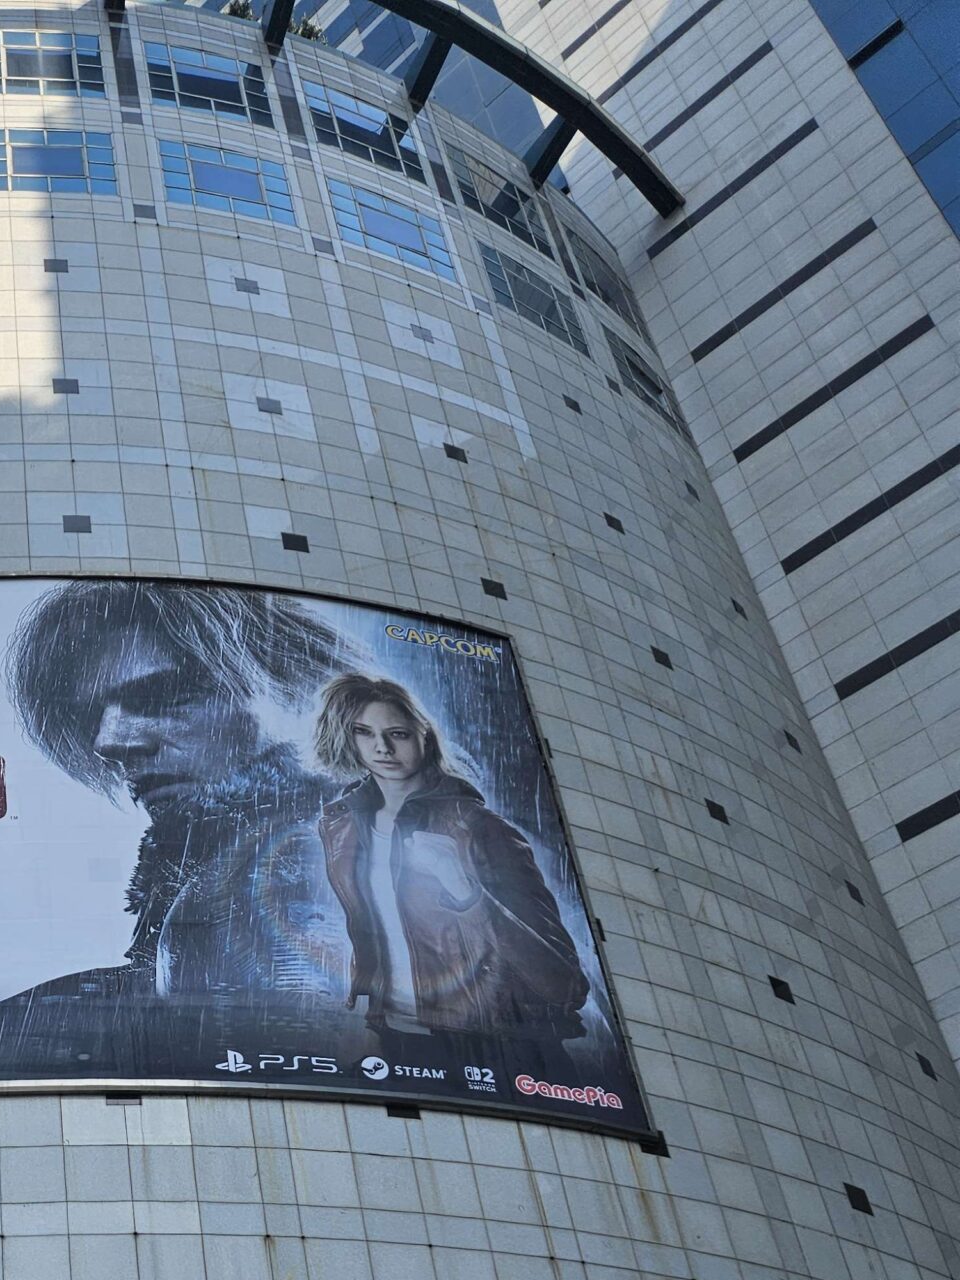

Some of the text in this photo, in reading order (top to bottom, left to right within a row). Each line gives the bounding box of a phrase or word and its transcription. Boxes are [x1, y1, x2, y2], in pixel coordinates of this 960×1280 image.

[384, 623, 500, 663] CAPCOM
[259, 1054, 339, 1073] PS5
[394, 1064, 446, 1080] STEAM
[515, 1074, 624, 1109] GamePia
